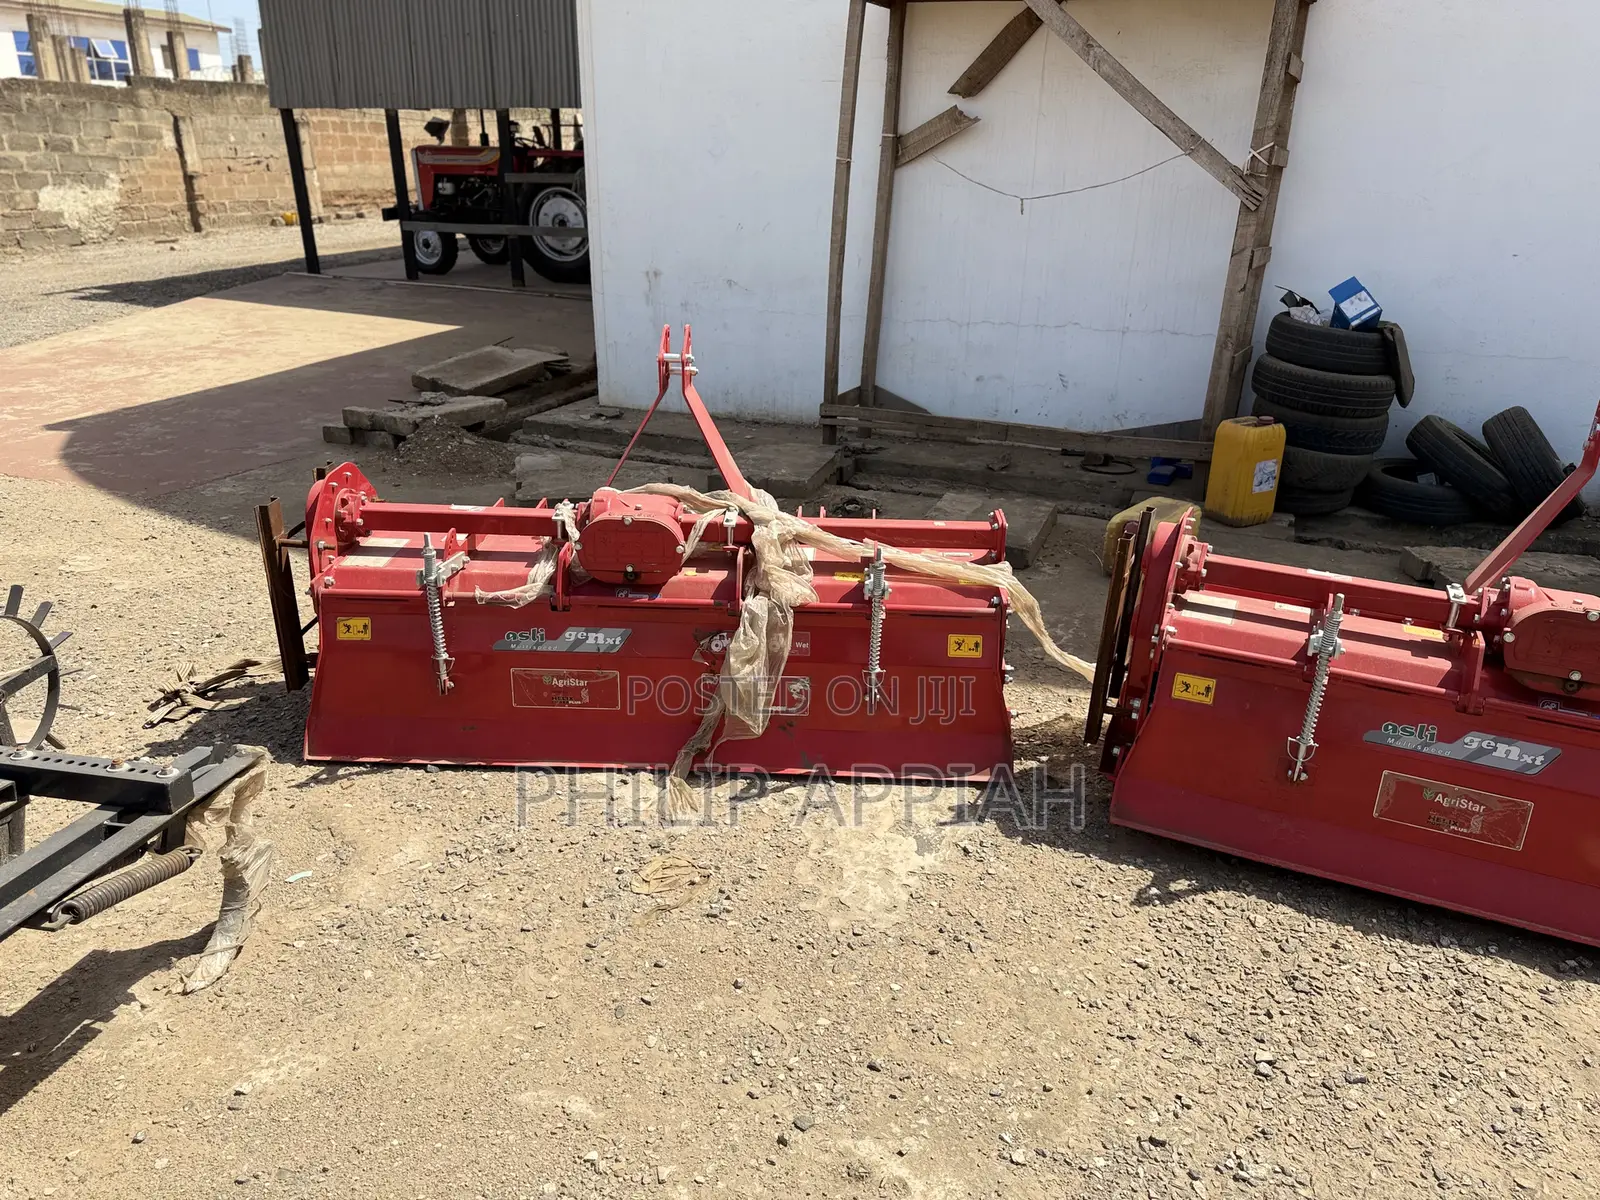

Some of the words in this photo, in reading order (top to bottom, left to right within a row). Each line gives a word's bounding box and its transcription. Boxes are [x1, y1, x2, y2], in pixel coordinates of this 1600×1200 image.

[505, 628, 545, 642] asli
[552, 678, 588, 687] AgriStar
[1381, 721, 1438, 743] asli
[1434, 792, 1486, 813] AgriStar
[1450, 825, 1468, 833] PLUS
